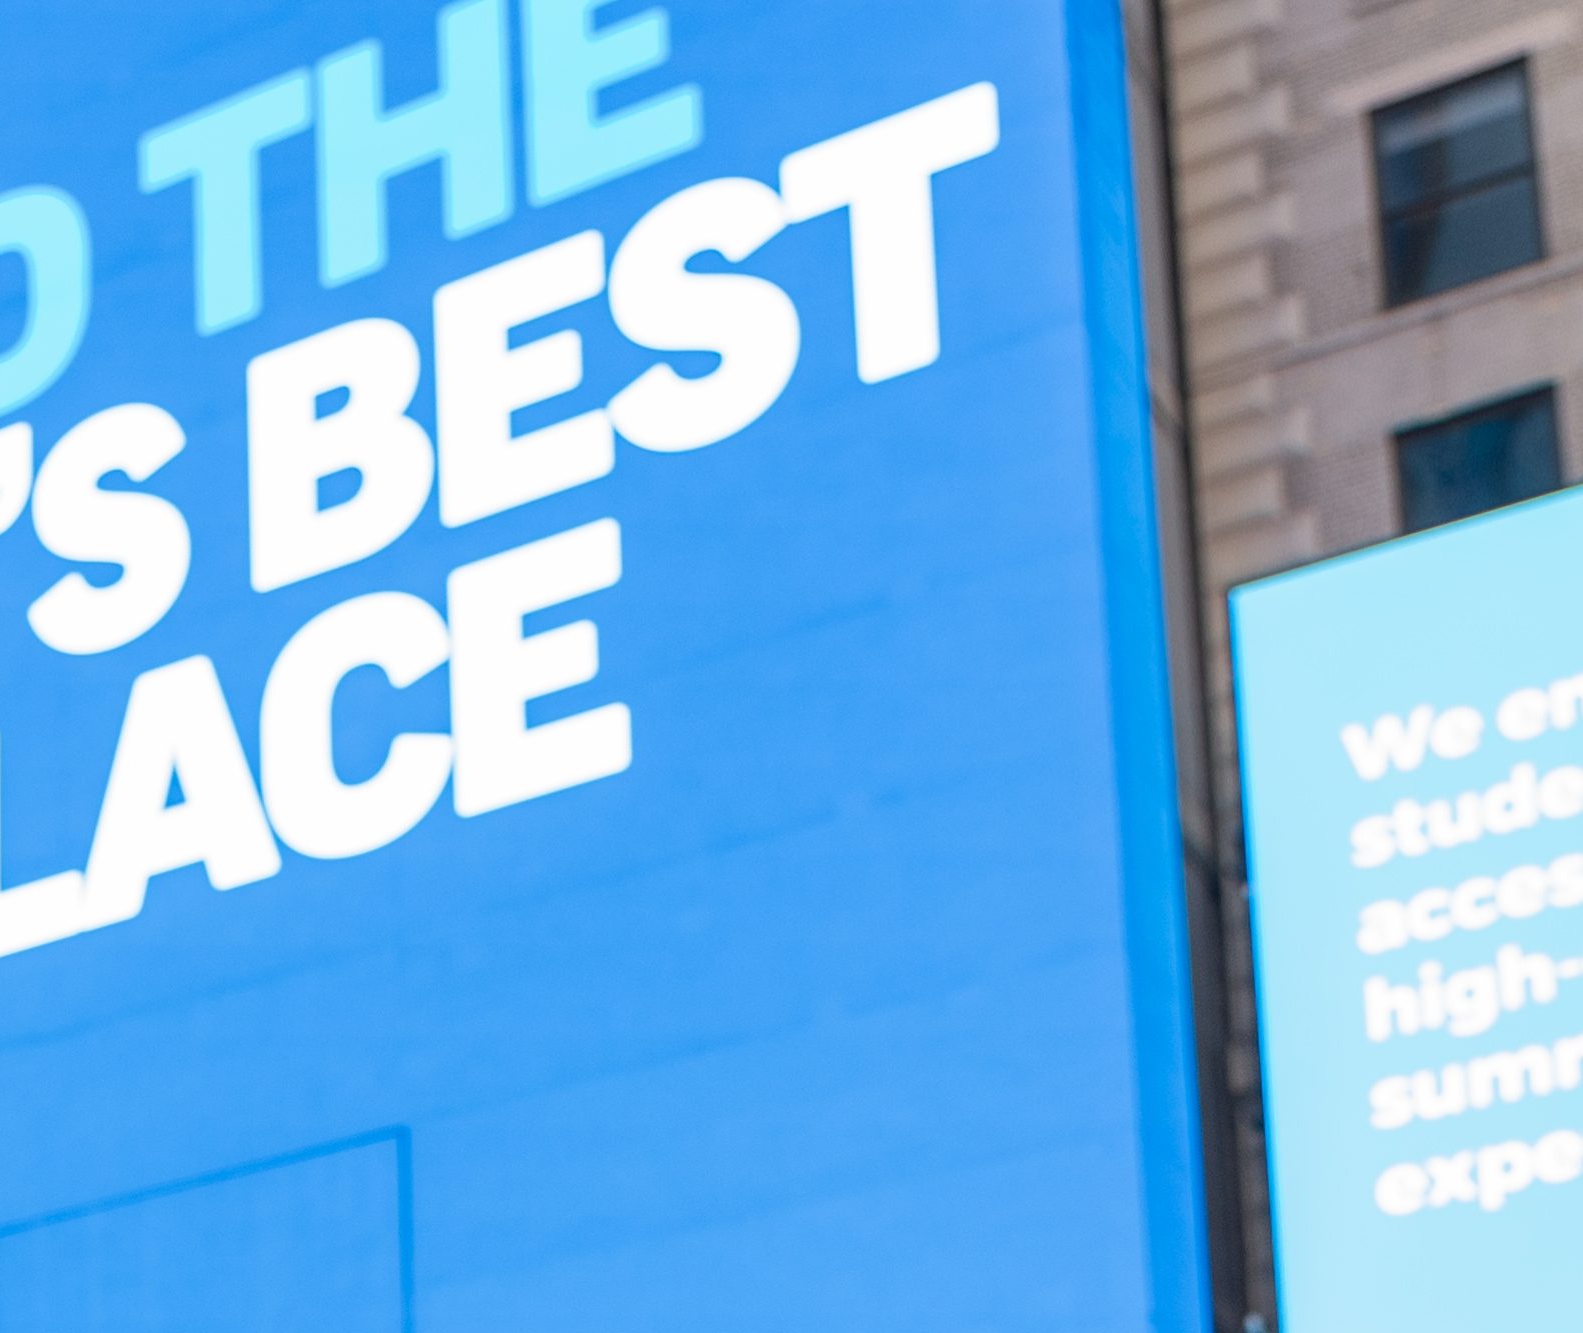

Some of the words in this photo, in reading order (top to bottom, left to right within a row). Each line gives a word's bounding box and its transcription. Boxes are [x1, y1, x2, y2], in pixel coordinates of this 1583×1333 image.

[137, 0, 703, 336] THE
[246, 80, 1001, 594] BEST
[1340, 702, 1485, 781] We
